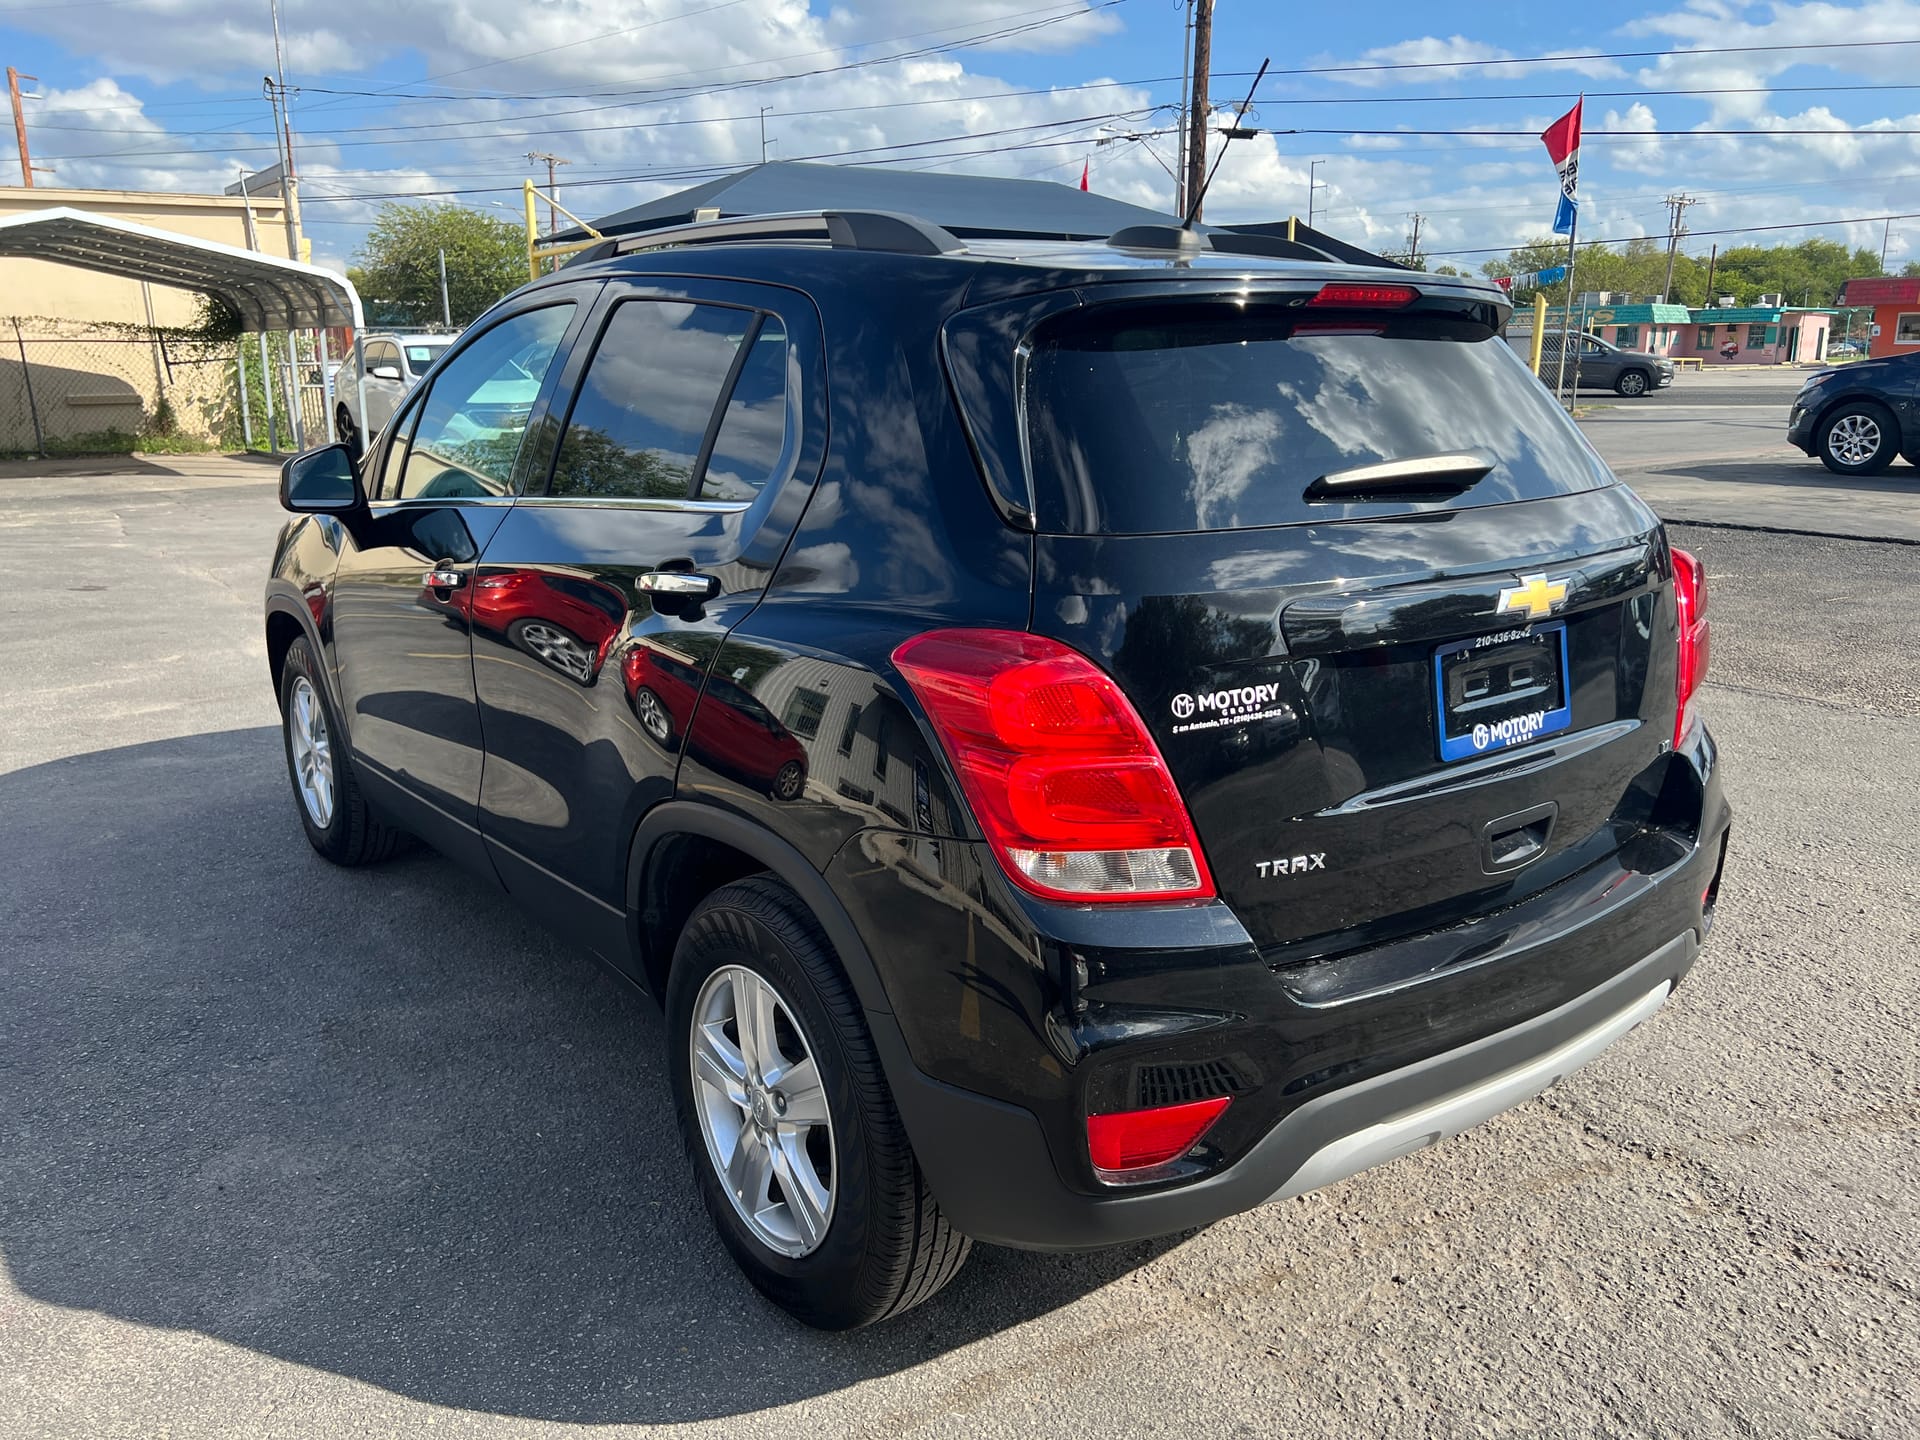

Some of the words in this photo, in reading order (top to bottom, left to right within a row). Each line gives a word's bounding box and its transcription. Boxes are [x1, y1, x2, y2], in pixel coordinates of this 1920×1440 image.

[1199, 682, 1280, 712] MOTORY
[1222, 704, 1261, 716] GROUP
[1491, 711, 1545, 742] MOTORY
[1506, 732, 1533, 746] GROUP
[1255, 852, 1326, 878] TRAX
